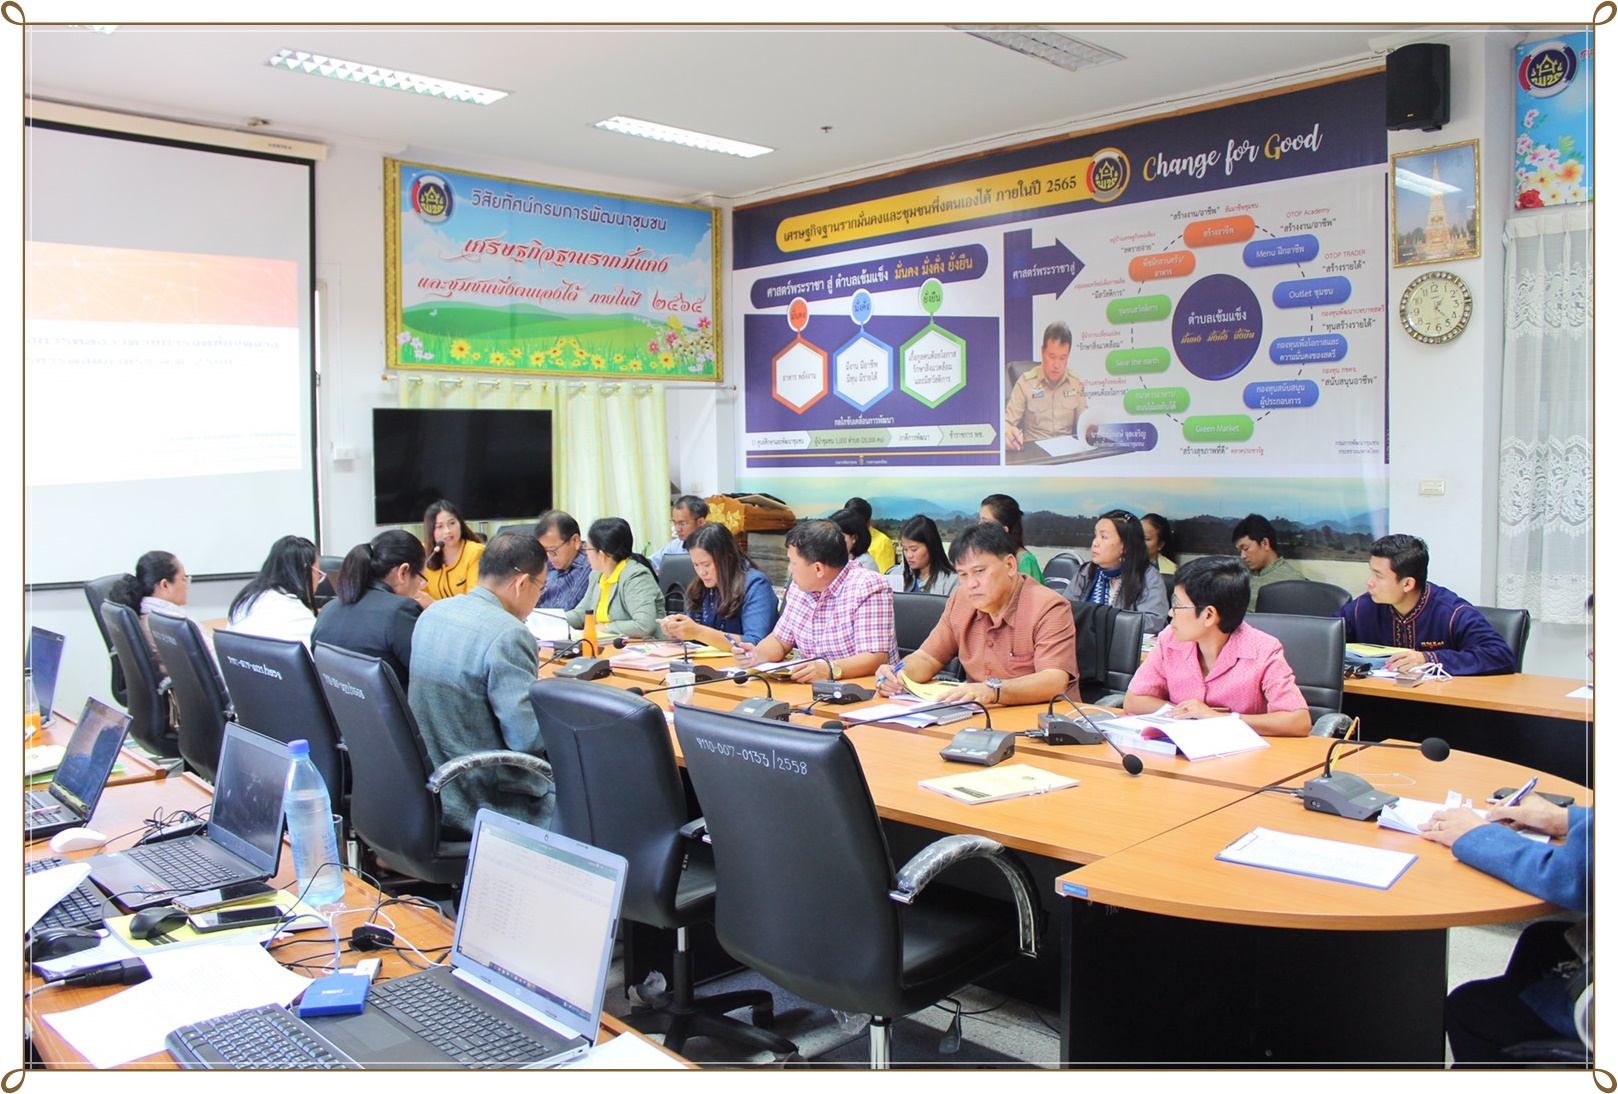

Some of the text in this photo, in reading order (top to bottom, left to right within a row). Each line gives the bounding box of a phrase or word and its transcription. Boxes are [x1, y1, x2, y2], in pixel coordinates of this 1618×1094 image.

[1141, 122, 1323, 182] Change for Good
[471, 187, 668, 233] วิสัยทัศน์กรมการพัฒนาชุมชน
[783, 175, 1078, 244] เศรษฐกิจฐานรากมั่นคงและชุมชนพึ่งตนเองได้ ภายในปี 2565
[1286, 209, 1304, 218] OTOP
[1203, 225, 1235, 238] สร้างอาชีพ
[456, 233, 672, 275] เศรษฐกิจฐานรากมั่นคง
[1255, 243, 1305, 258] Menu ฝึกอาชีพ
[1324, 248, 1366, 260] OTOP TRADER
[766, 252, 974, 299] ศาสตร์พระราชา สู่ ตำบลเข้มแข็ง มั่นคง มั่งคั่ง ยั่งยืน
[1012, 261, 1076, 279] ศาสตร์พระราชาสู่
[417, 275, 582, 303] และชุมชนพึ่งตนเองได้
[588, 285, 642, 307] ภายในปี
[1288, 287, 1334, 299] Outlet ชุมชน
[1187, 305, 1248, 327] ตำบลเข้มแข็ง
[1115, 356, 1160, 367] Save the earth
[1259, 395, 1302, 408] ผู้ประกอบการ
[1195, 423, 1240, 434] Green Market
